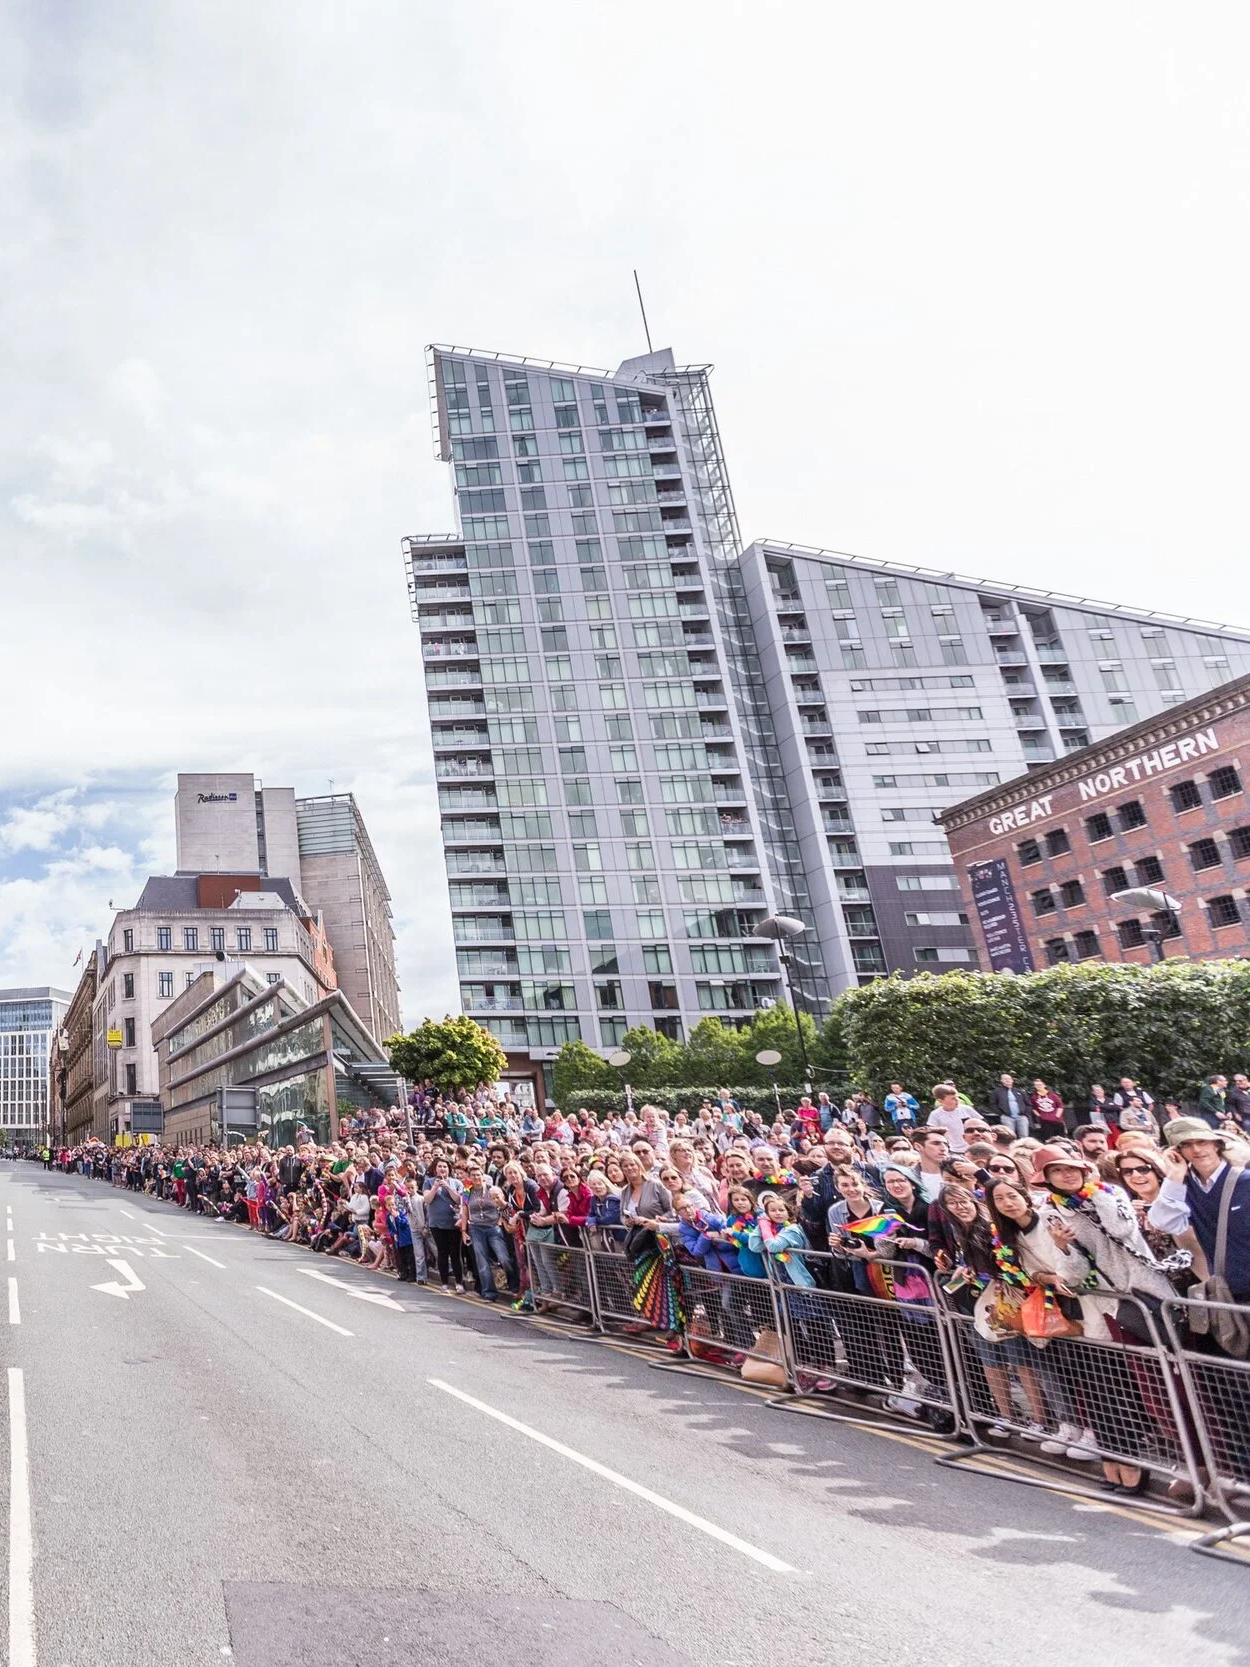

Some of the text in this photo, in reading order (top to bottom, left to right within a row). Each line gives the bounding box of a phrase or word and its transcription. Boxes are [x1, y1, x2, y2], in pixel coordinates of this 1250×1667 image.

[989, 728, 1219, 835] GREAT NORTHERN
[197, 792, 229, 804] Radisson
[31, 1232, 167, 1245] RIGHT
[36, 1242, 181, 1258] TURN
